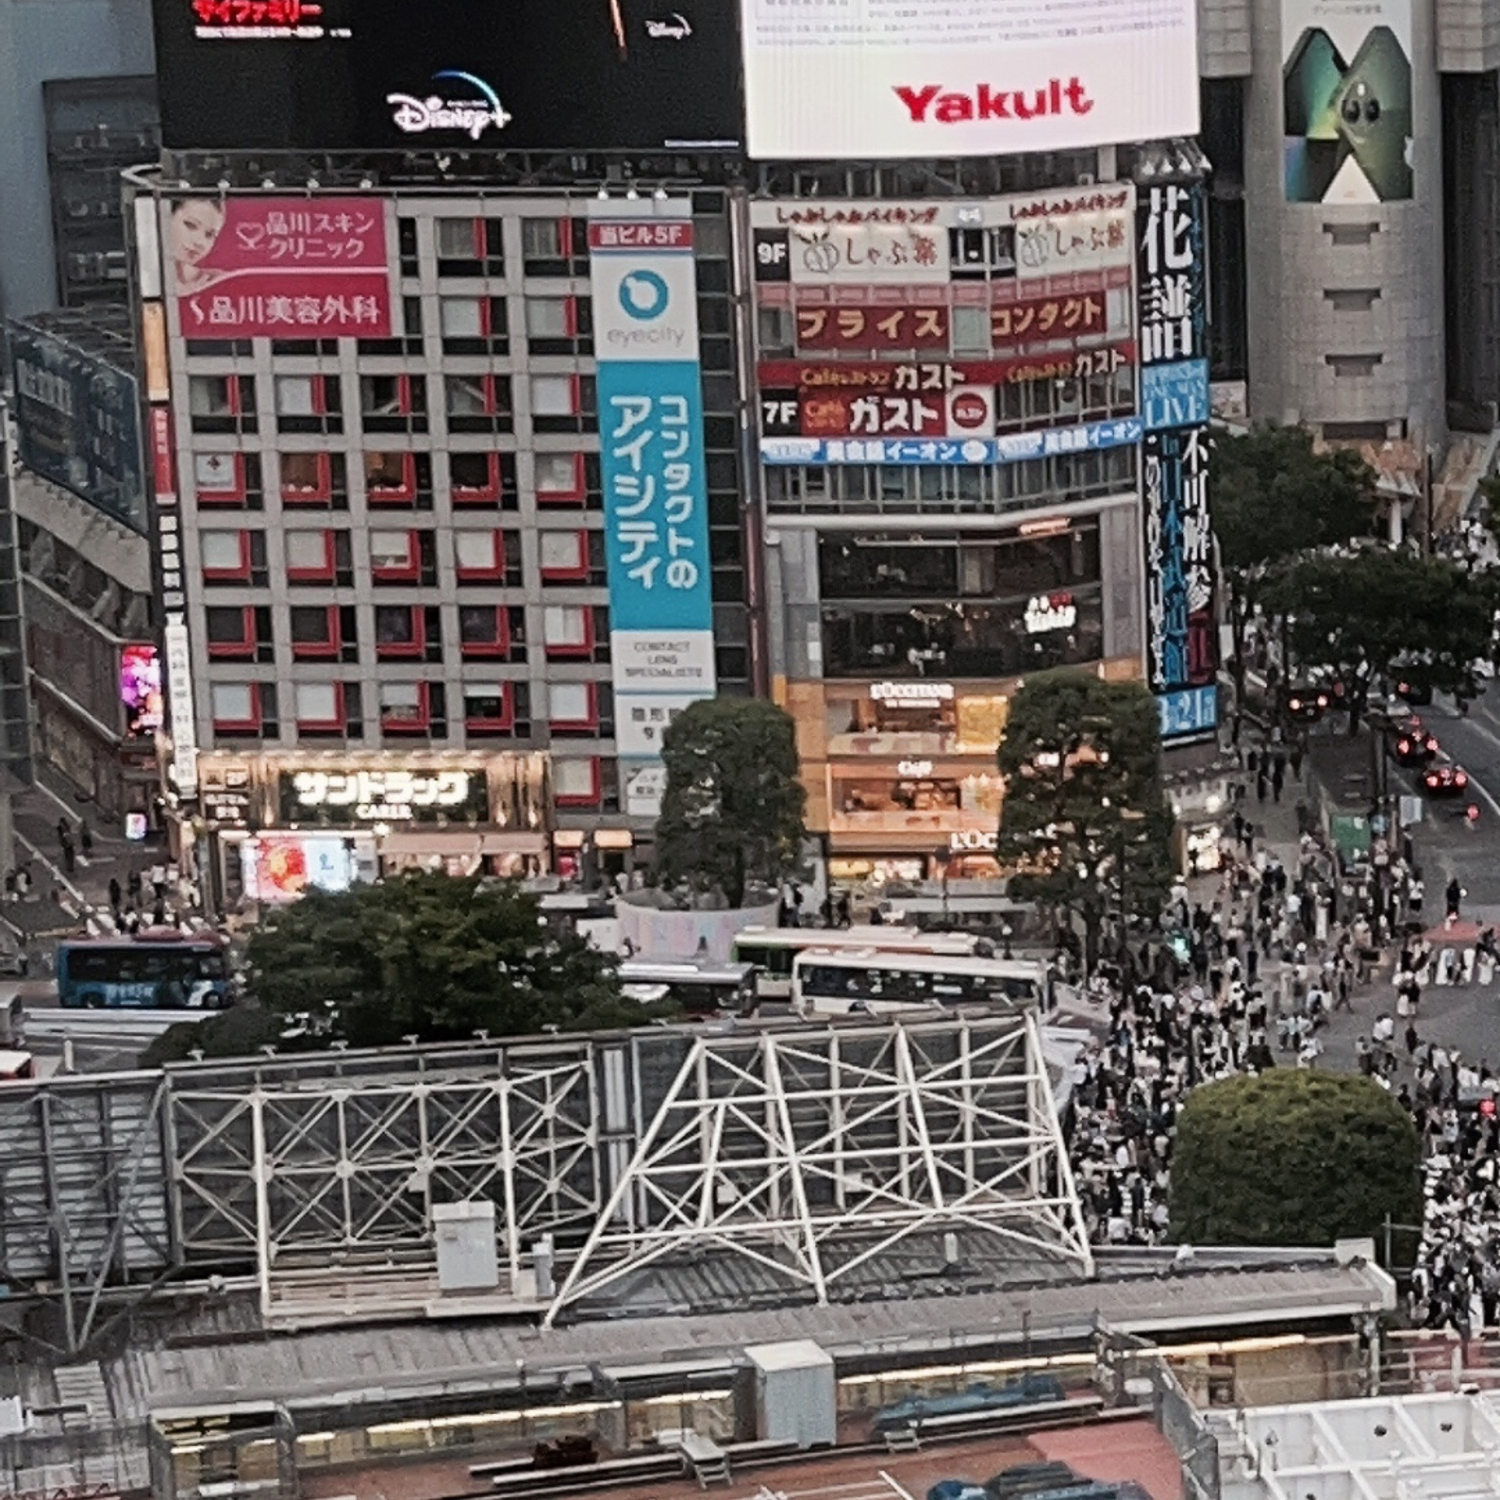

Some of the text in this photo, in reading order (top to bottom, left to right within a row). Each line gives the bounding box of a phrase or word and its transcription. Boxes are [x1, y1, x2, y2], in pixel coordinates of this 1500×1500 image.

[892, 76, 1094, 124] Yakult
[386, 93, 511, 141] Disney+
[264, 212, 375, 235] 品川スキン
[265, 238, 365, 259] クリニック
[757, 242, 787, 264] 9F
[209, 296, 381, 325] 品川美容外科
[991, 296, 1102, 337] コンタクト
[606, 326, 685, 348] eyecity
[1074, 348, 1127, 377] ガスト
[893, 364, 966, 391] ガスト
[762, 401, 798, 425] 7F
[850, 396, 939, 433] ガスト
[609, 396, 660, 590] アイシティ
[660, 395, 699, 589] コンタクトの
[633, 641, 691, 653] CONTACT
[293, 771, 470, 805] サンドラッグ
